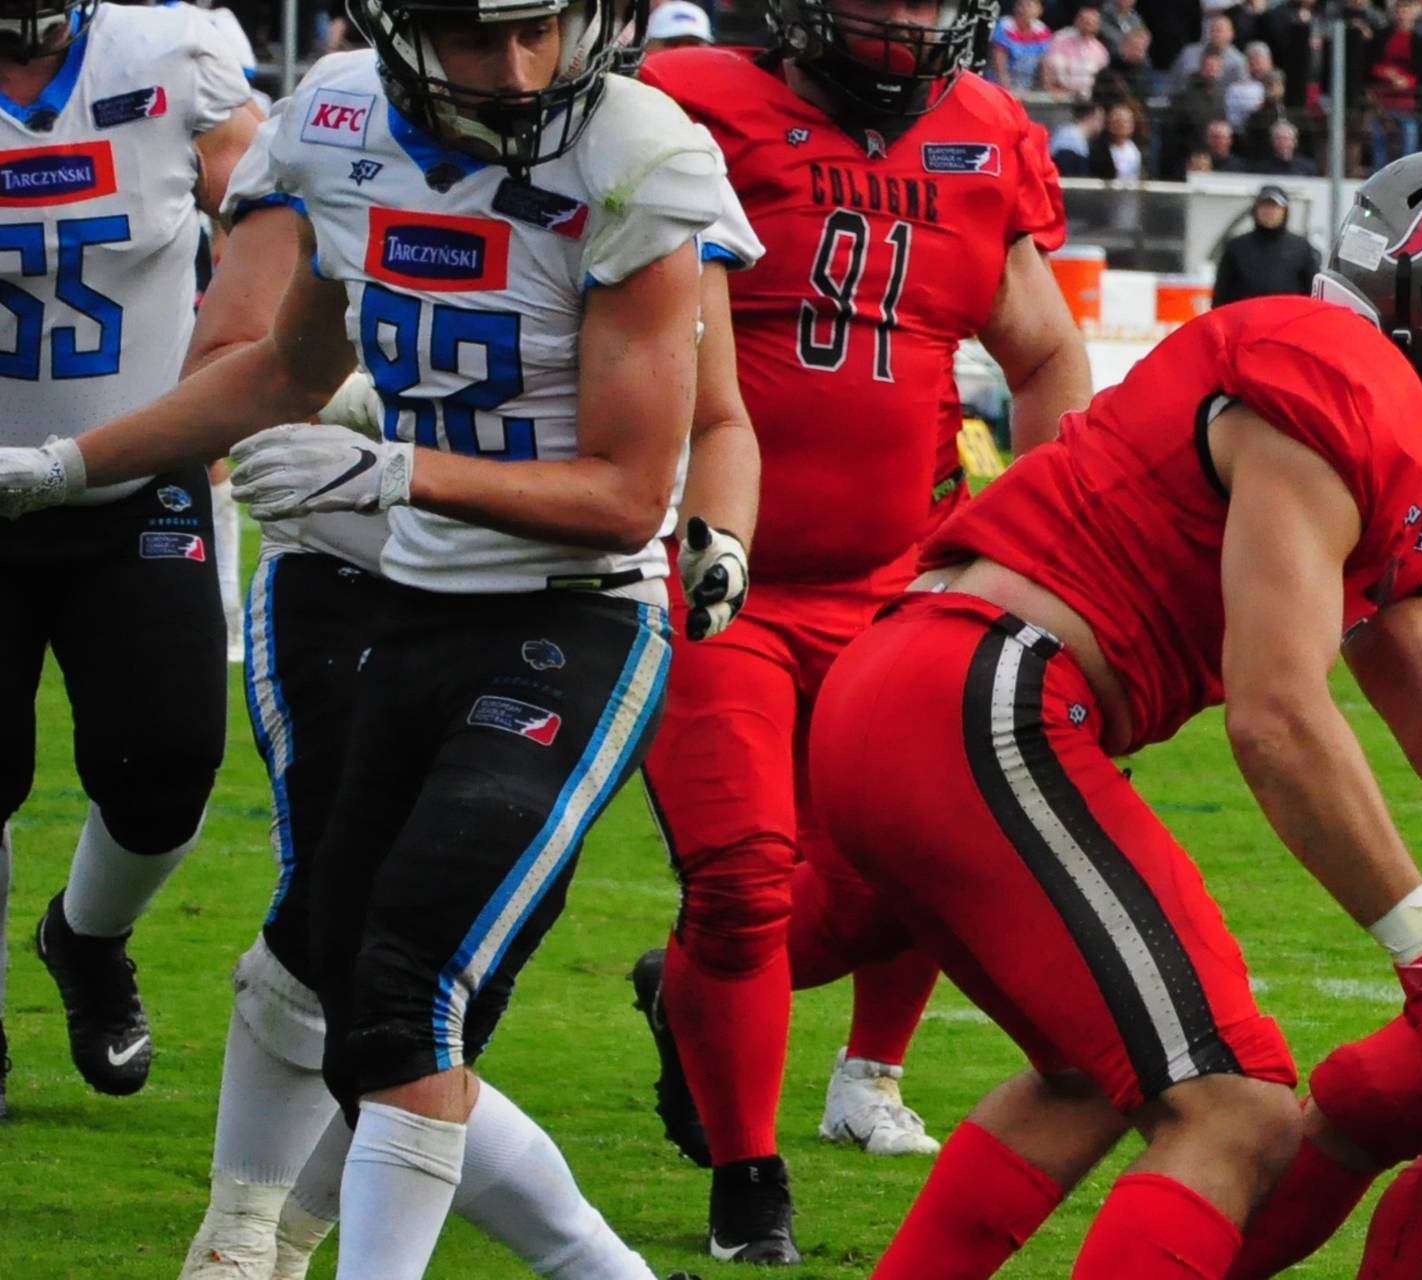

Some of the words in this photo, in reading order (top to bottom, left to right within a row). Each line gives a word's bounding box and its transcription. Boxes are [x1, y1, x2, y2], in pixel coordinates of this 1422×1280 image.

[310, 103, 367, 132] KFC
[810, 161, 938, 224] COLOGNE
[388, 236, 477, 269] TARCZYŃSKI
[797, 207, 912, 382] 91
[361, 281, 538, 461] 82
